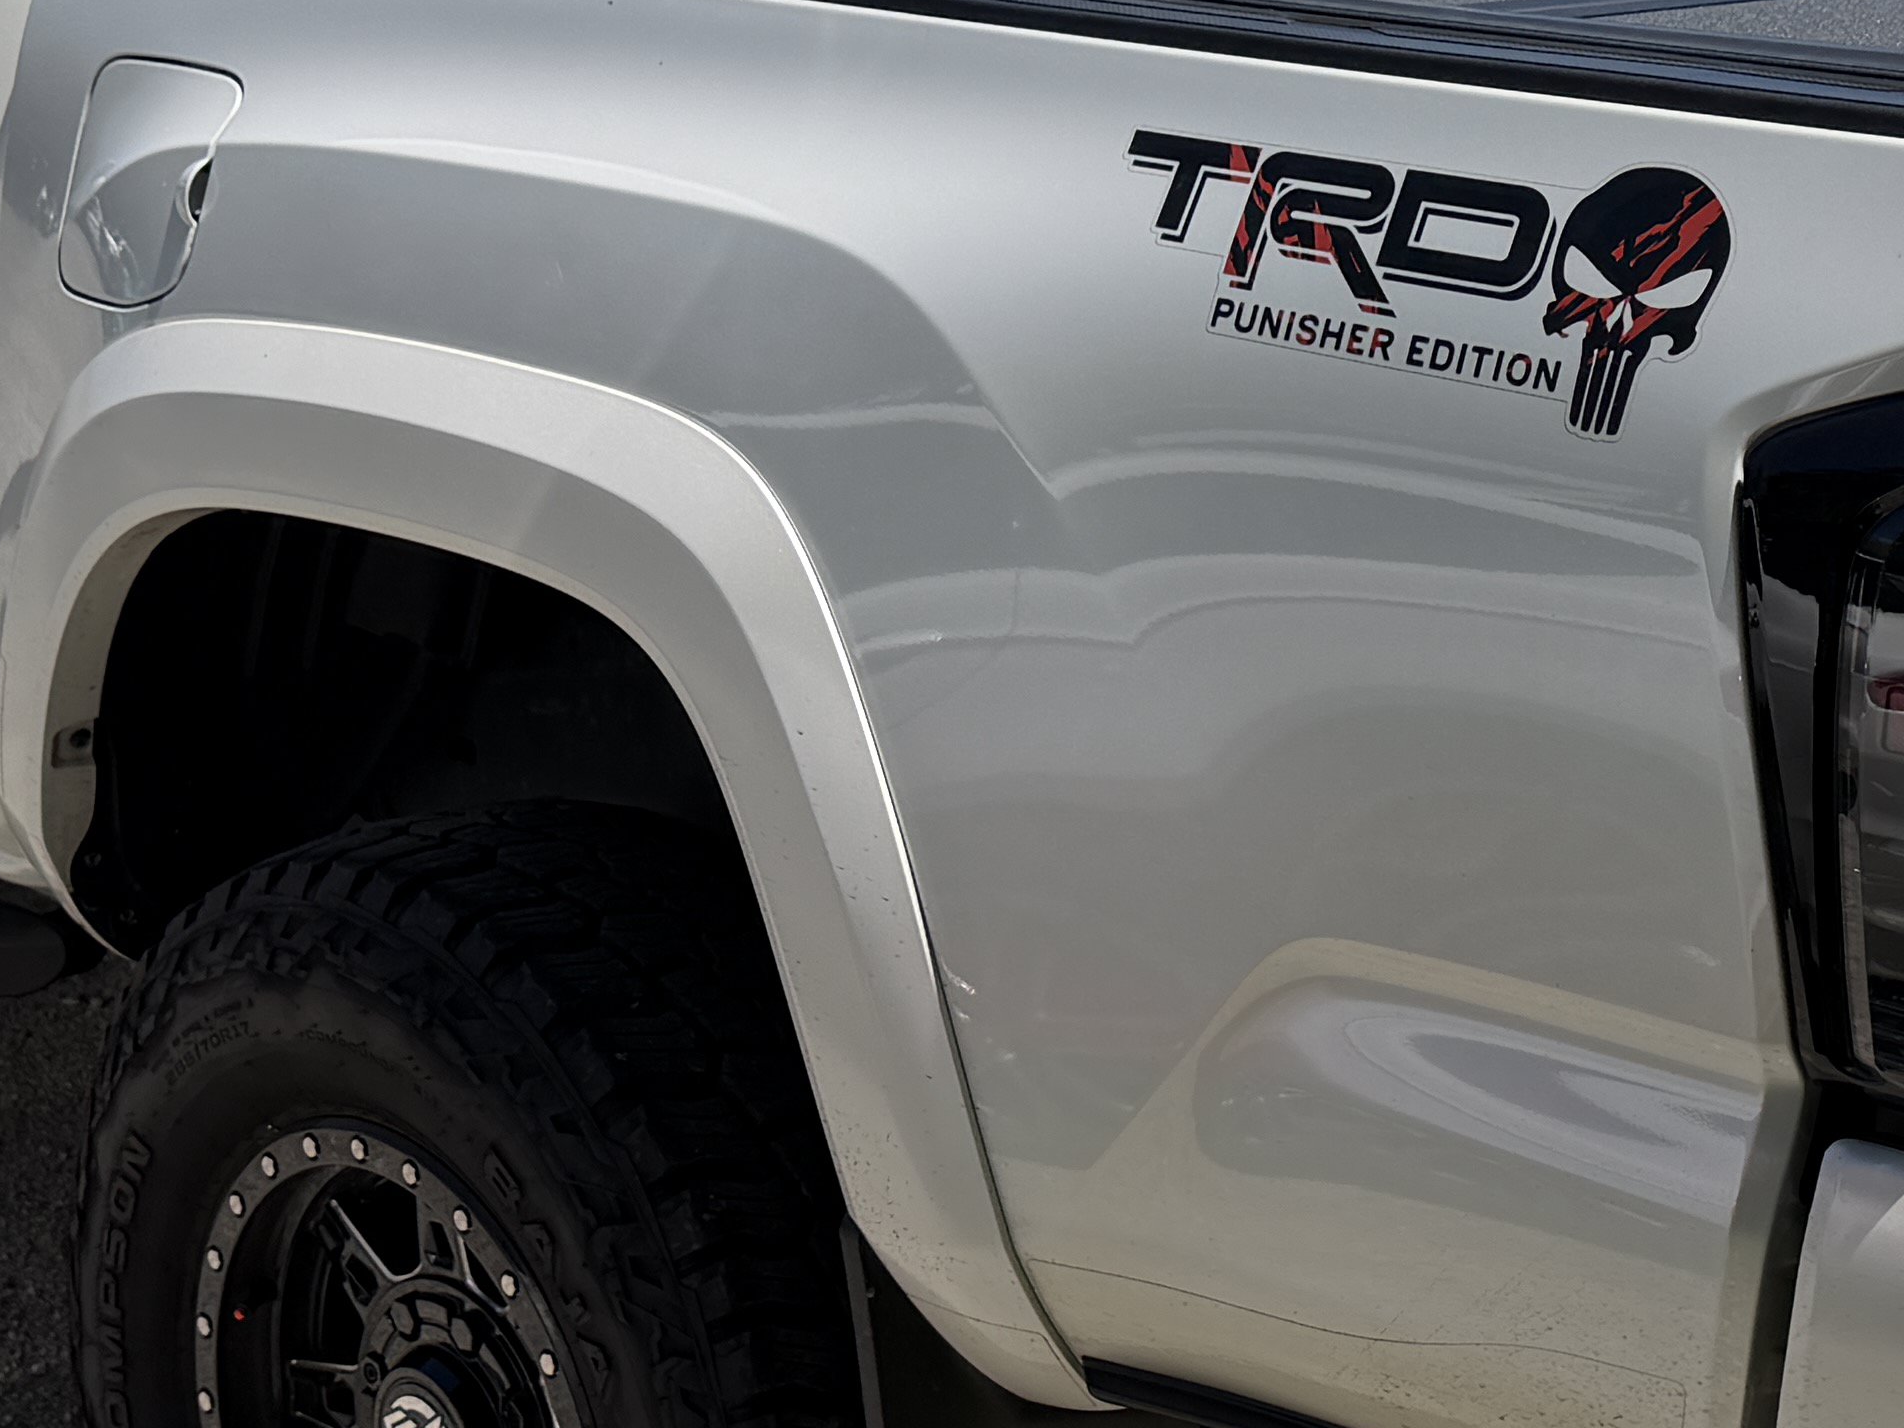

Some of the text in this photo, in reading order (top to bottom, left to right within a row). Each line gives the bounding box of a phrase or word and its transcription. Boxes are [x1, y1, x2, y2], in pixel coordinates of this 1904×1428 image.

[1127, 128, 1557, 318] TRD
[1211, 298, 1561, 393] PUNISHER EDITION
